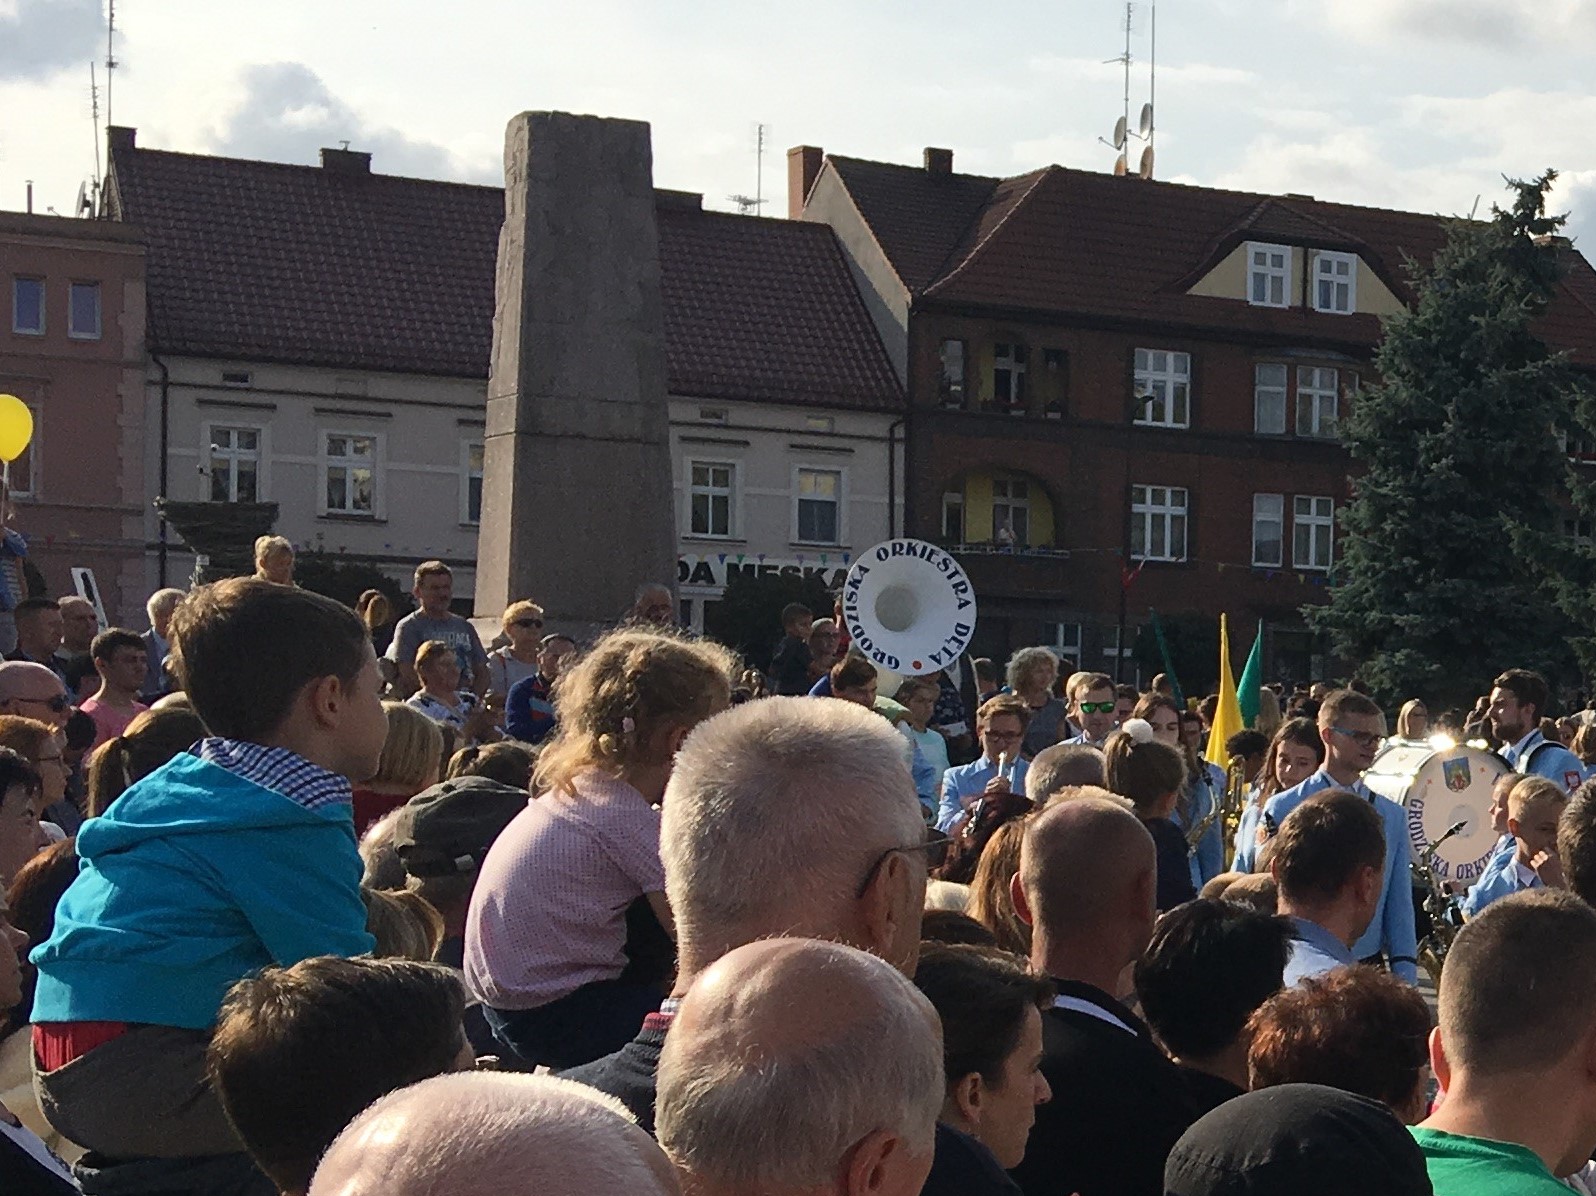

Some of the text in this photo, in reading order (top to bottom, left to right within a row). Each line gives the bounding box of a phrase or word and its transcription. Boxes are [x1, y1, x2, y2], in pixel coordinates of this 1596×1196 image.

[845, 541, 972, 670] GRODZISKA ORKIESTRA DĘTA
[1408, 798, 1450, 877] GRODZKA
